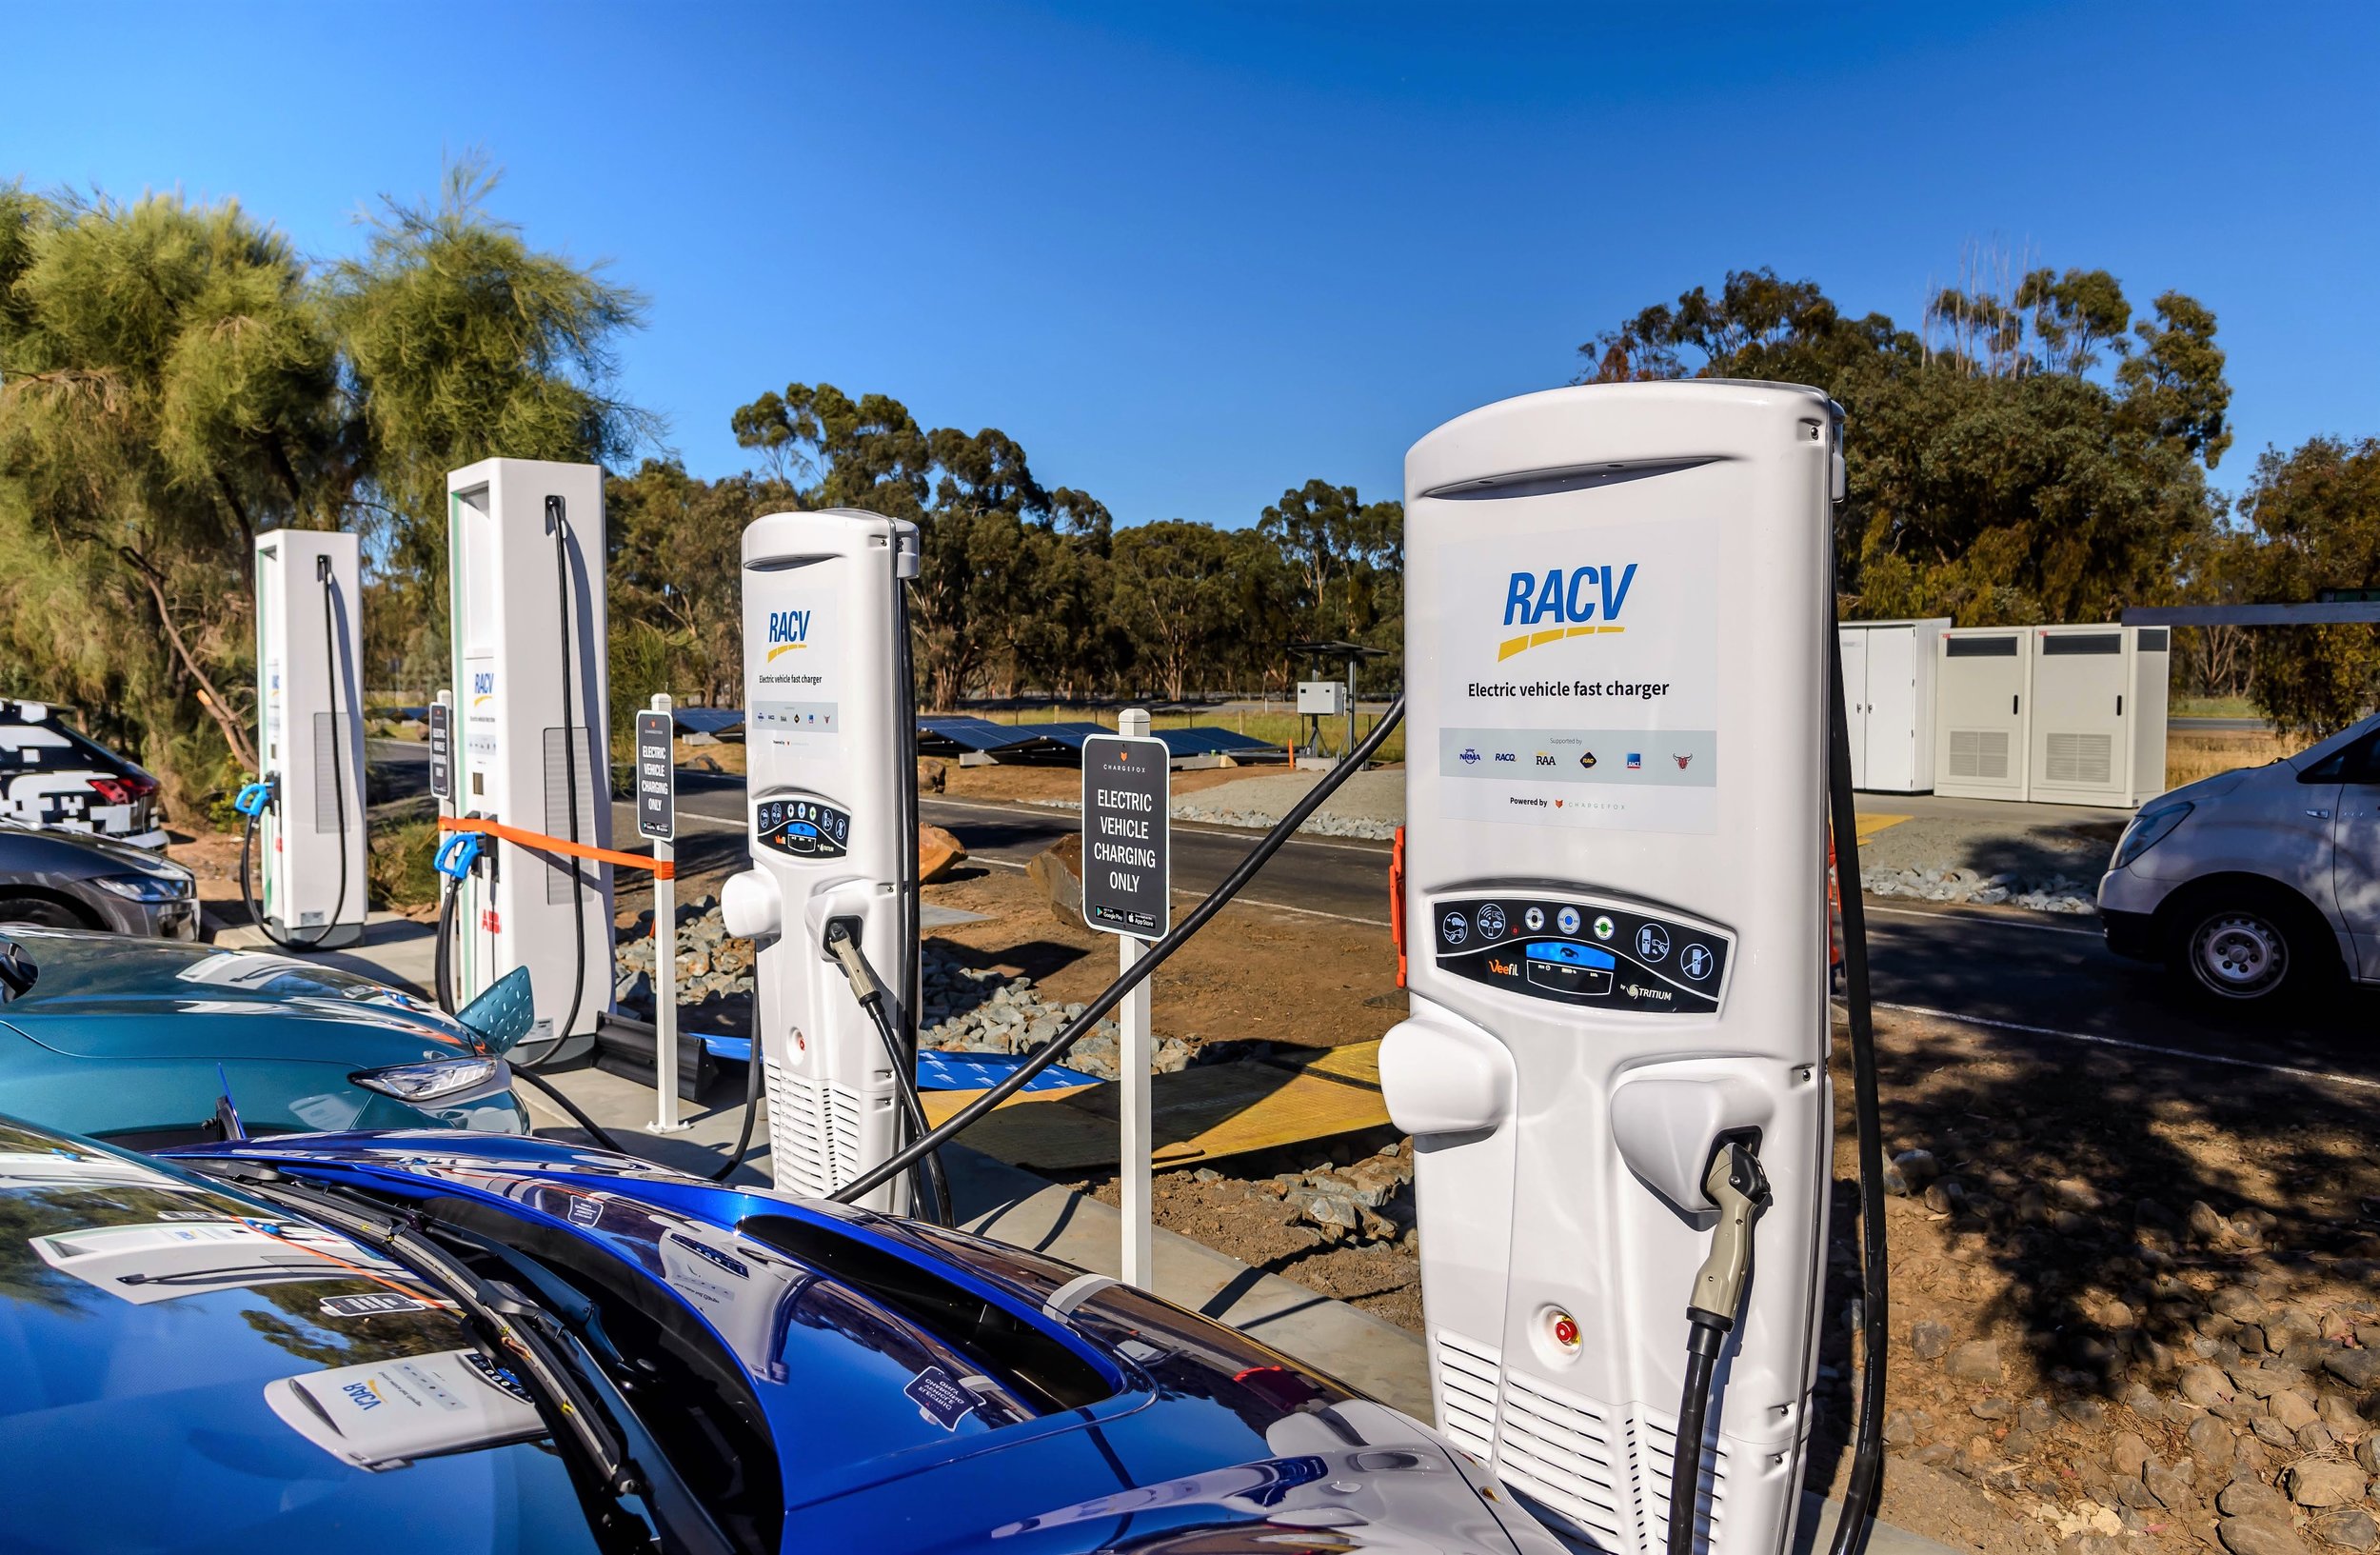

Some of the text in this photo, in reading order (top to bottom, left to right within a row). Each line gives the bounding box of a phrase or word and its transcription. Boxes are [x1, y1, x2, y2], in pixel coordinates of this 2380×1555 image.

[1502, 563, 1638, 627] RACV
[769, 610, 811, 643] RACV
[475, 672, 494, 694] RACV
[791, 674, 801, 684] fast
[802, 674, 823, 686] charger
[1468, 680, 1670, 700] Electric vehicle fast charger
[642, 746, 666, 760] ELECTRIC
[1495, 753, 1516, 762] RACQ
[1536, 755, 1557, 766] RAA
[644, 763, 665, 777] VEHICLE
[1103, 764, 1146, 773] CHARGEFOX
[641, 780, 668, 795] CHARGING
[647, 798, 663, 812] ONLY
[1098, 788, 1152, 812] ELECTRIC
[1510, 797, 1537, 807] Powered
[1538, 798, 1548, 807] by
[1100, 815, 1149, 840] VEHICLE
[1094, 842, 1156, 868] CHARGING
[1109, 871, 1140, 893] ONLY
[1488, 959, 1519, 977] Veefil
[1638, 987, 1673, 1001] TRITIUM
